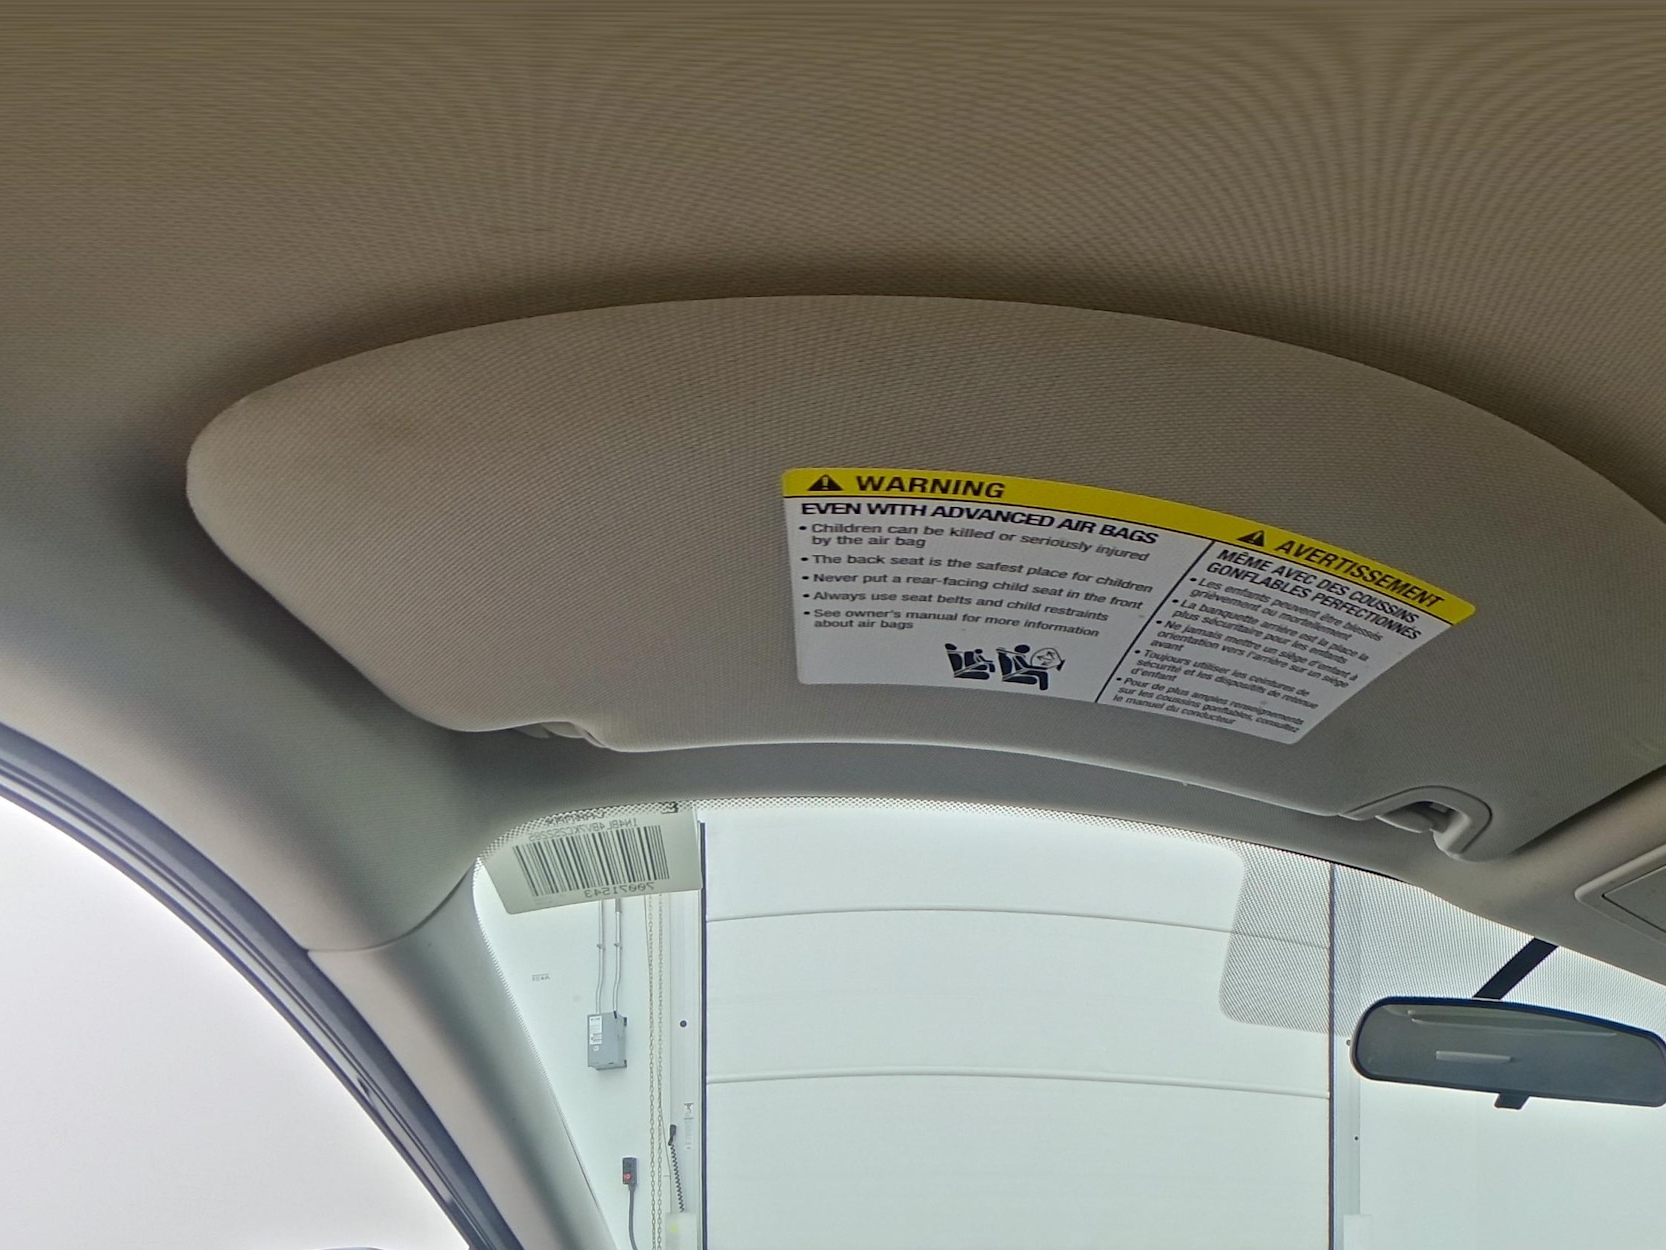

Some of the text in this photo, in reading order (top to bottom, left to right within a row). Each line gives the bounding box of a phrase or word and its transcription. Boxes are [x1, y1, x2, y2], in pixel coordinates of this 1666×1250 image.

[856, 475, 1006, 498] WARNING
[801, 502, 1160, 544] EVEN WITH ADVANCED AIR BAGS
[811, 535, 926, 548] by the air bag
[811, 523, 1150, 562] Children can be killed or seriously injured
[812, 554, 1154, 593] The back seat is the safest place for children
[1274, 540, 1445, 608] AVERTISSEMENT
[813, 573, 859, 583] Never
[862, 575, 888, 584] put
[905, 576, 989, 590] rear-facing
[992, 580, 1029, 593] child
[1032, 585, 1064, 597] seat
[1066, 588, 1081, 600] in
[1083, 591, 1107, 604] the
[1109, 596, 1144, 610] front
[1198, 578, 1223, 590] Les
[1217, 550, 1419, 623] MÊME AVEC DES COUSSINS
[813, 592, 1109, 622] Always use seat belts and child restraints
[1180, 600, 1197, 610] La
[1207, 562, 1421, 640] GONFLABLES PERFECTIONNÉS
[814, 609, 1100, 637] See owner's manual for more information
[814, 619, 914, 630] about air bags
[1164, 621, 1182, 630] Ne
[1171, 610, 1200, 621] plus
[1150, 640, 1184, 651] avant
[1144, 649, 1192, 666] Toujours
[1118, 687, 1136, 695] sur
[1123, 677, 1150, 688] Pour
[1151, 683, 1165, 691] de
